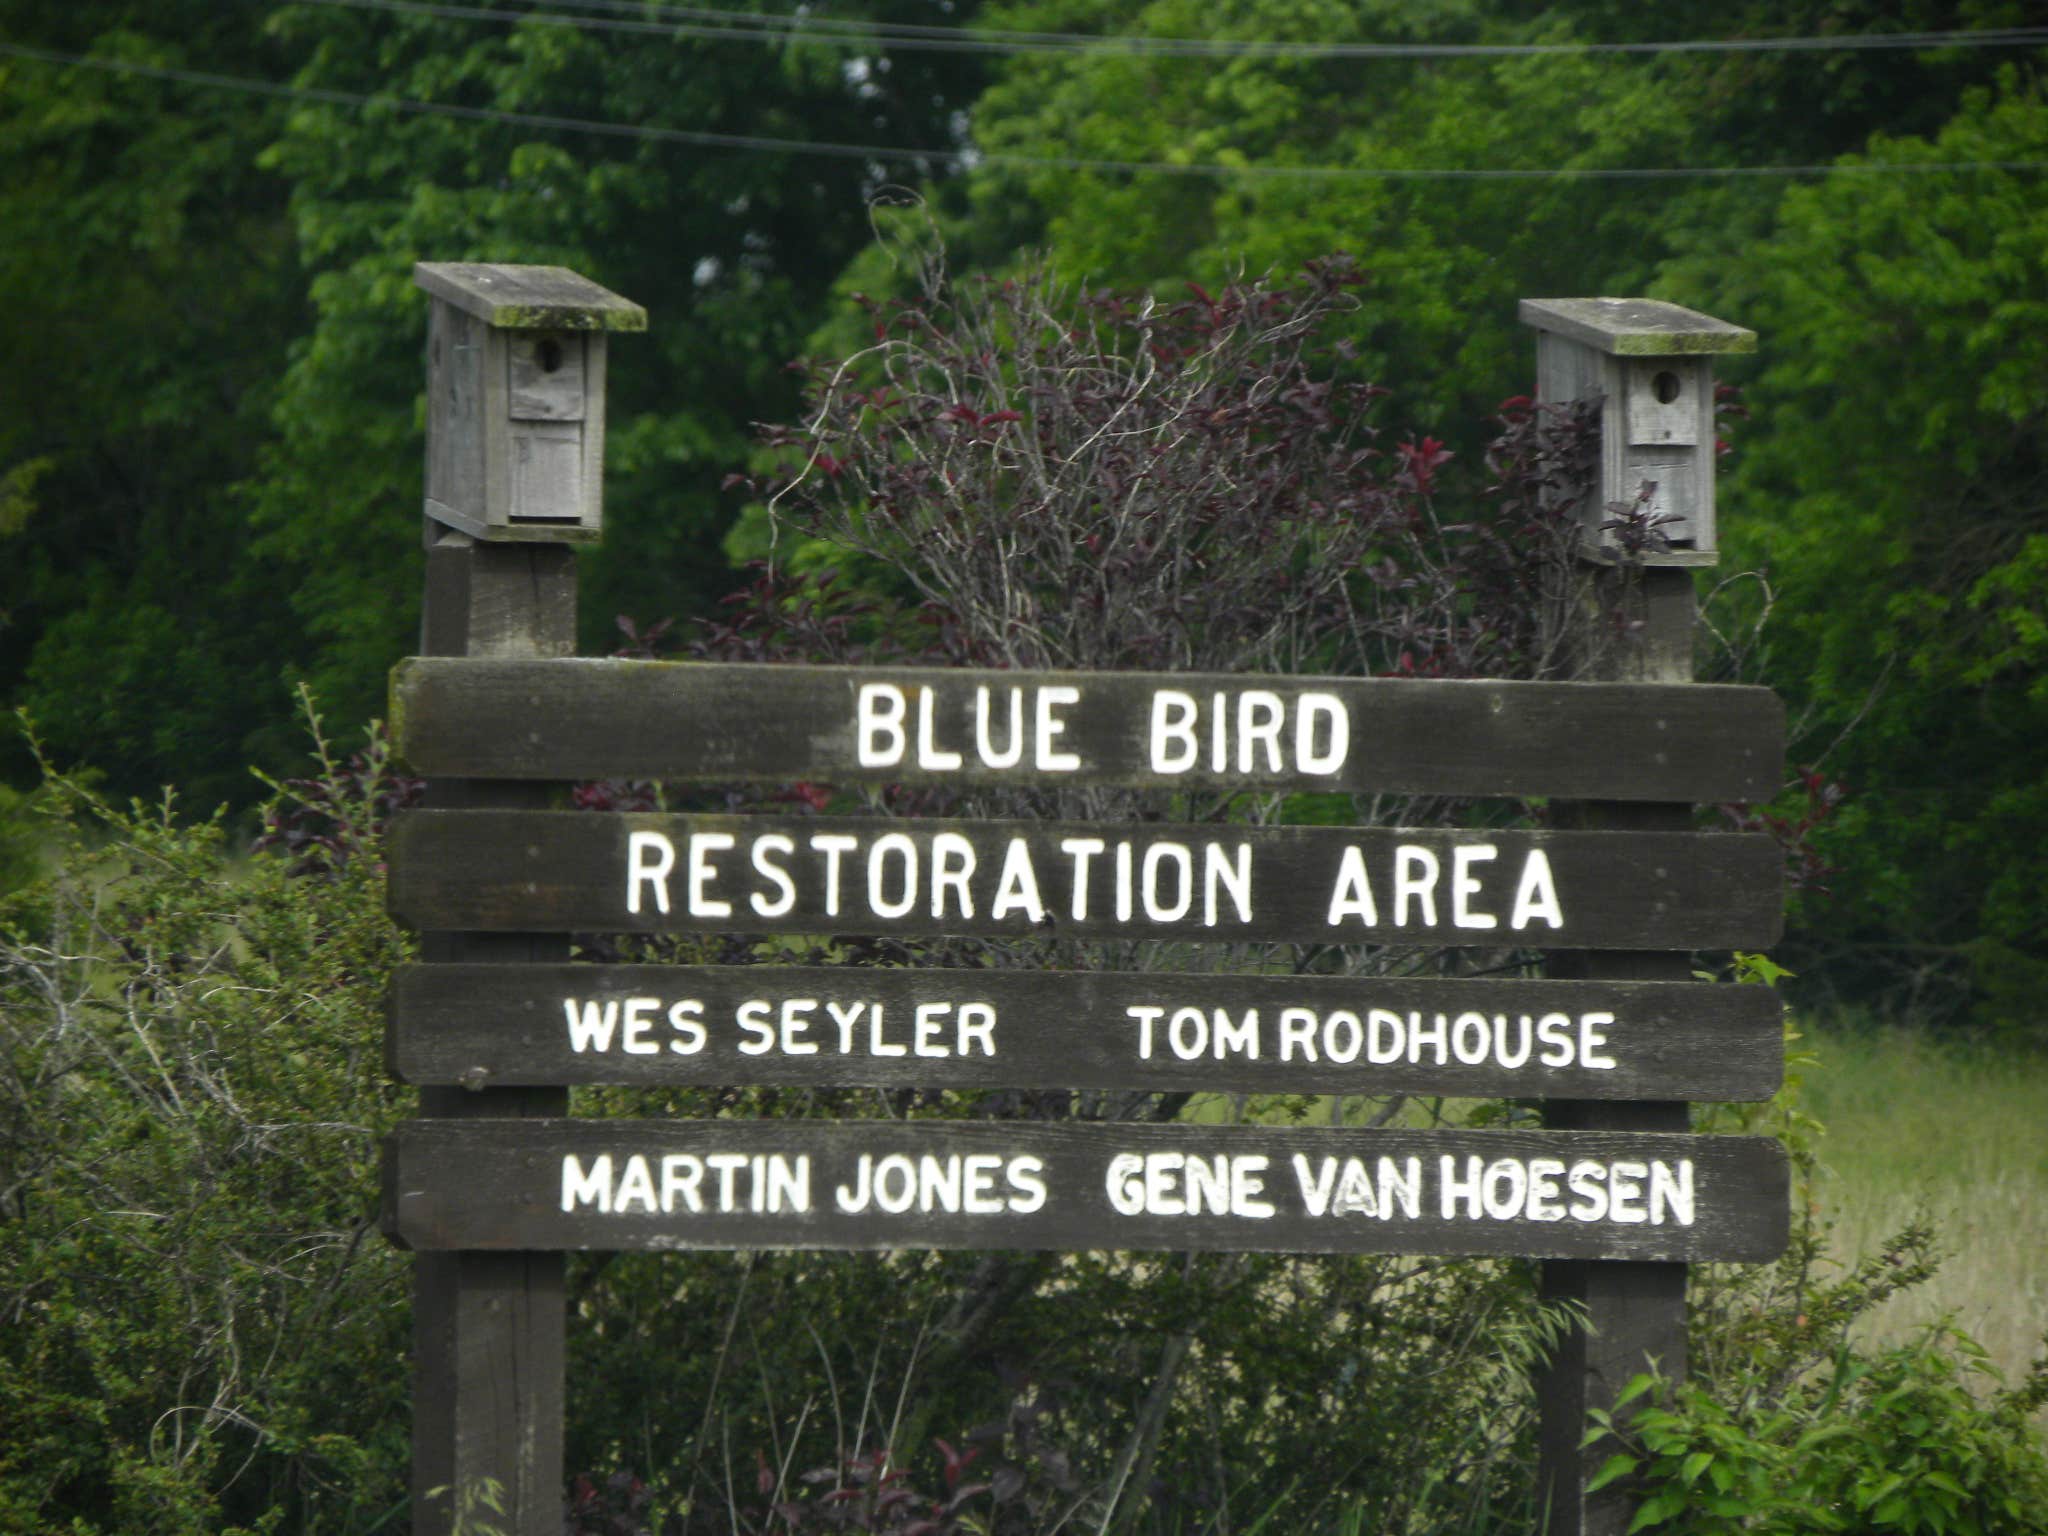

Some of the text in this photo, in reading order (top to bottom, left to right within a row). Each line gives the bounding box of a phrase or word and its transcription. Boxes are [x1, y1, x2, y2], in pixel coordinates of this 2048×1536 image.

[857, 682, 1350, 776] BLUE BIRD
[627, 830, 1564, 931] RESTORATION AREA
[563, 998, 998, 1057] WES SEYLER
[1125, 1005, 1618, 1070] TOM RODHOUSE
[561, 1153, 1047, 1216] MARTIN JONES
[1105, 1151, 1696, 1227] GENE VAN HOESEN
